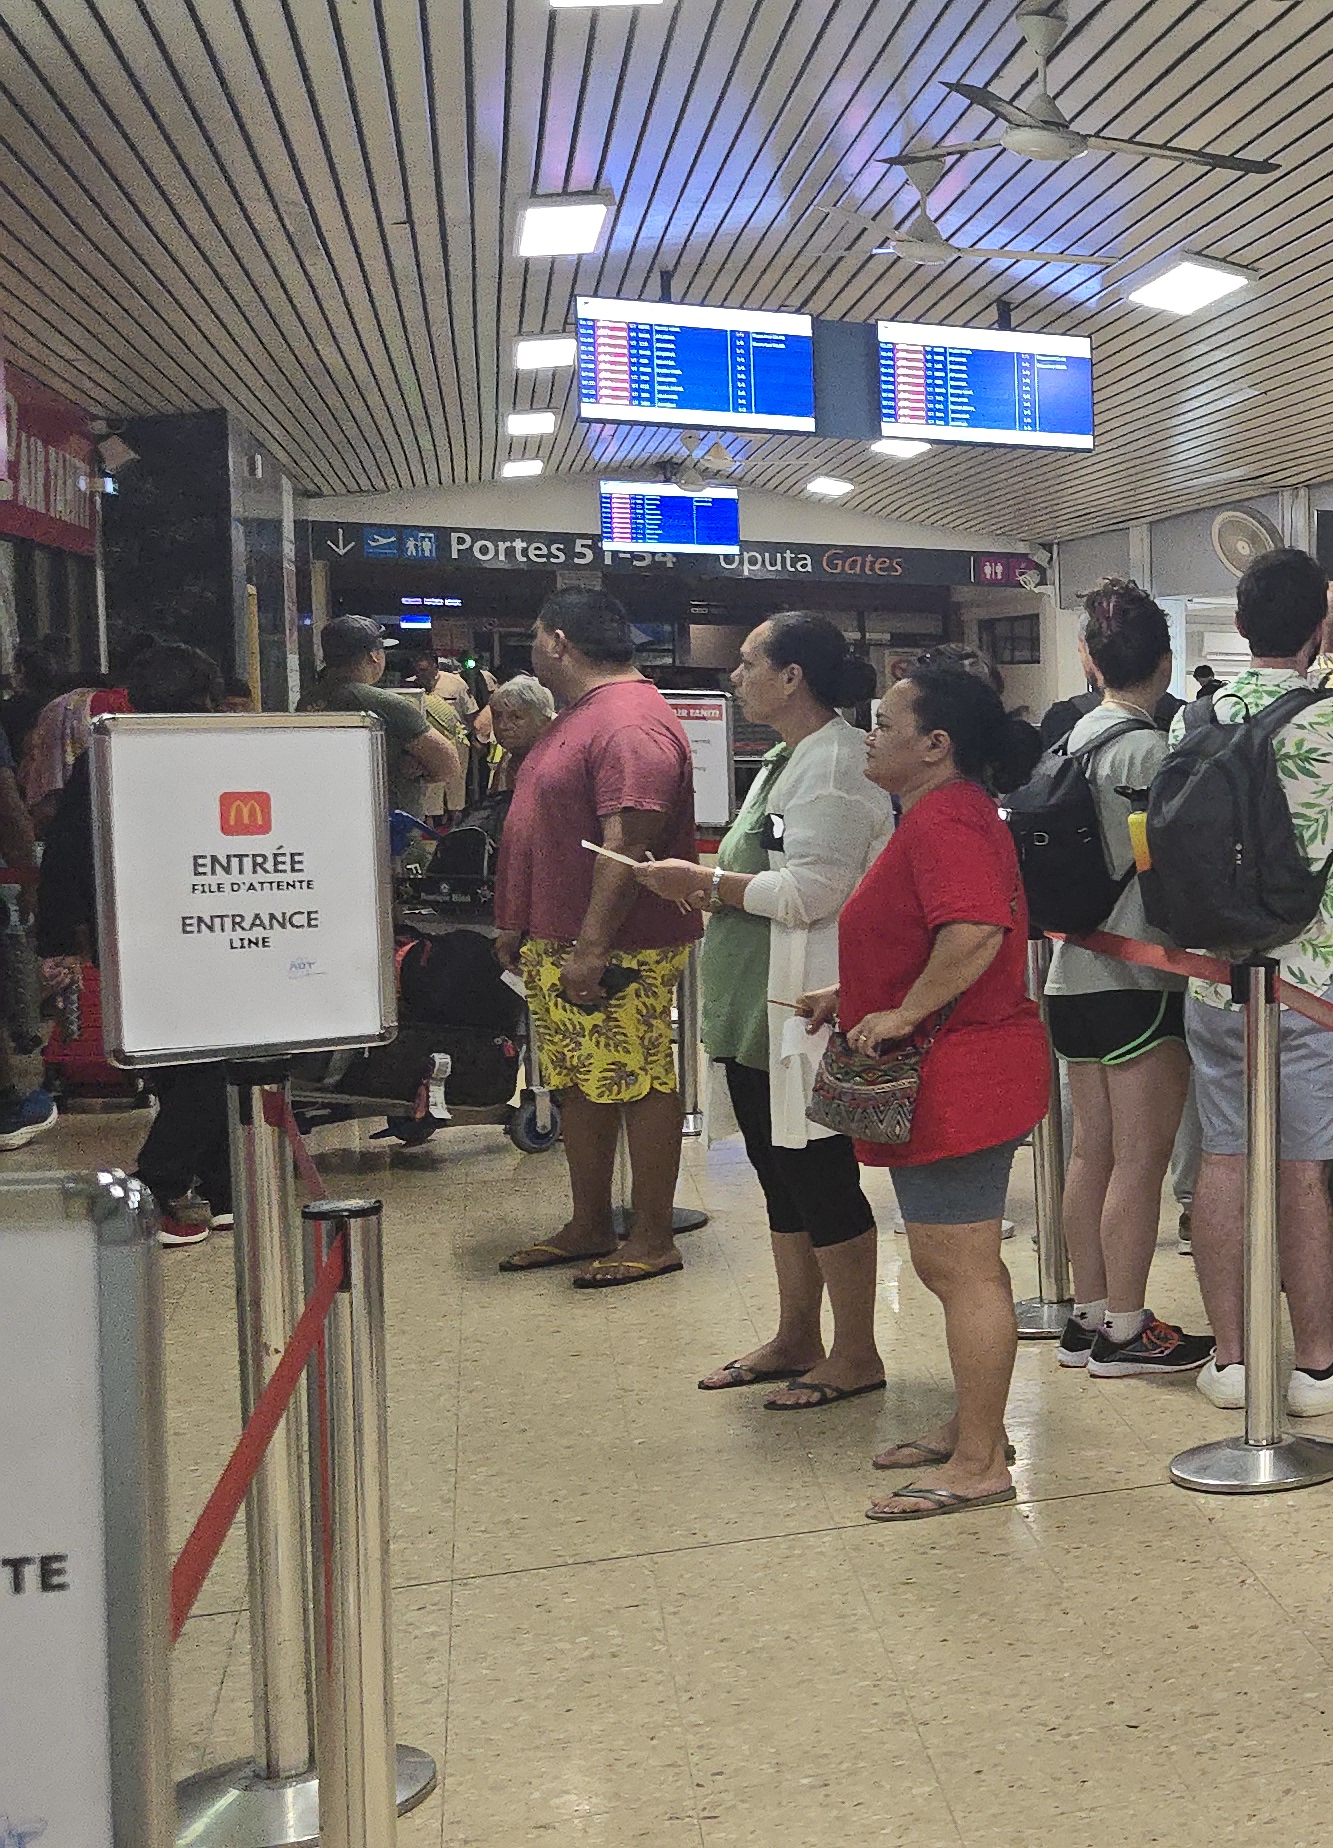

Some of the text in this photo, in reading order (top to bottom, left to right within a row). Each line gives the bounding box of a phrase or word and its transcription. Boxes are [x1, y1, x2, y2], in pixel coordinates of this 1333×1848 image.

[450, 532, 566, 563] Portes
[821, 549, 903, 576] Gates
[192, 844, 305, 877] ENTRÉE
[191, 879, 315, 894] FILE D'ATTENTE
[181, 910, 320, 935] ENTRANCE
[229, 936, 271, 950] LINE
